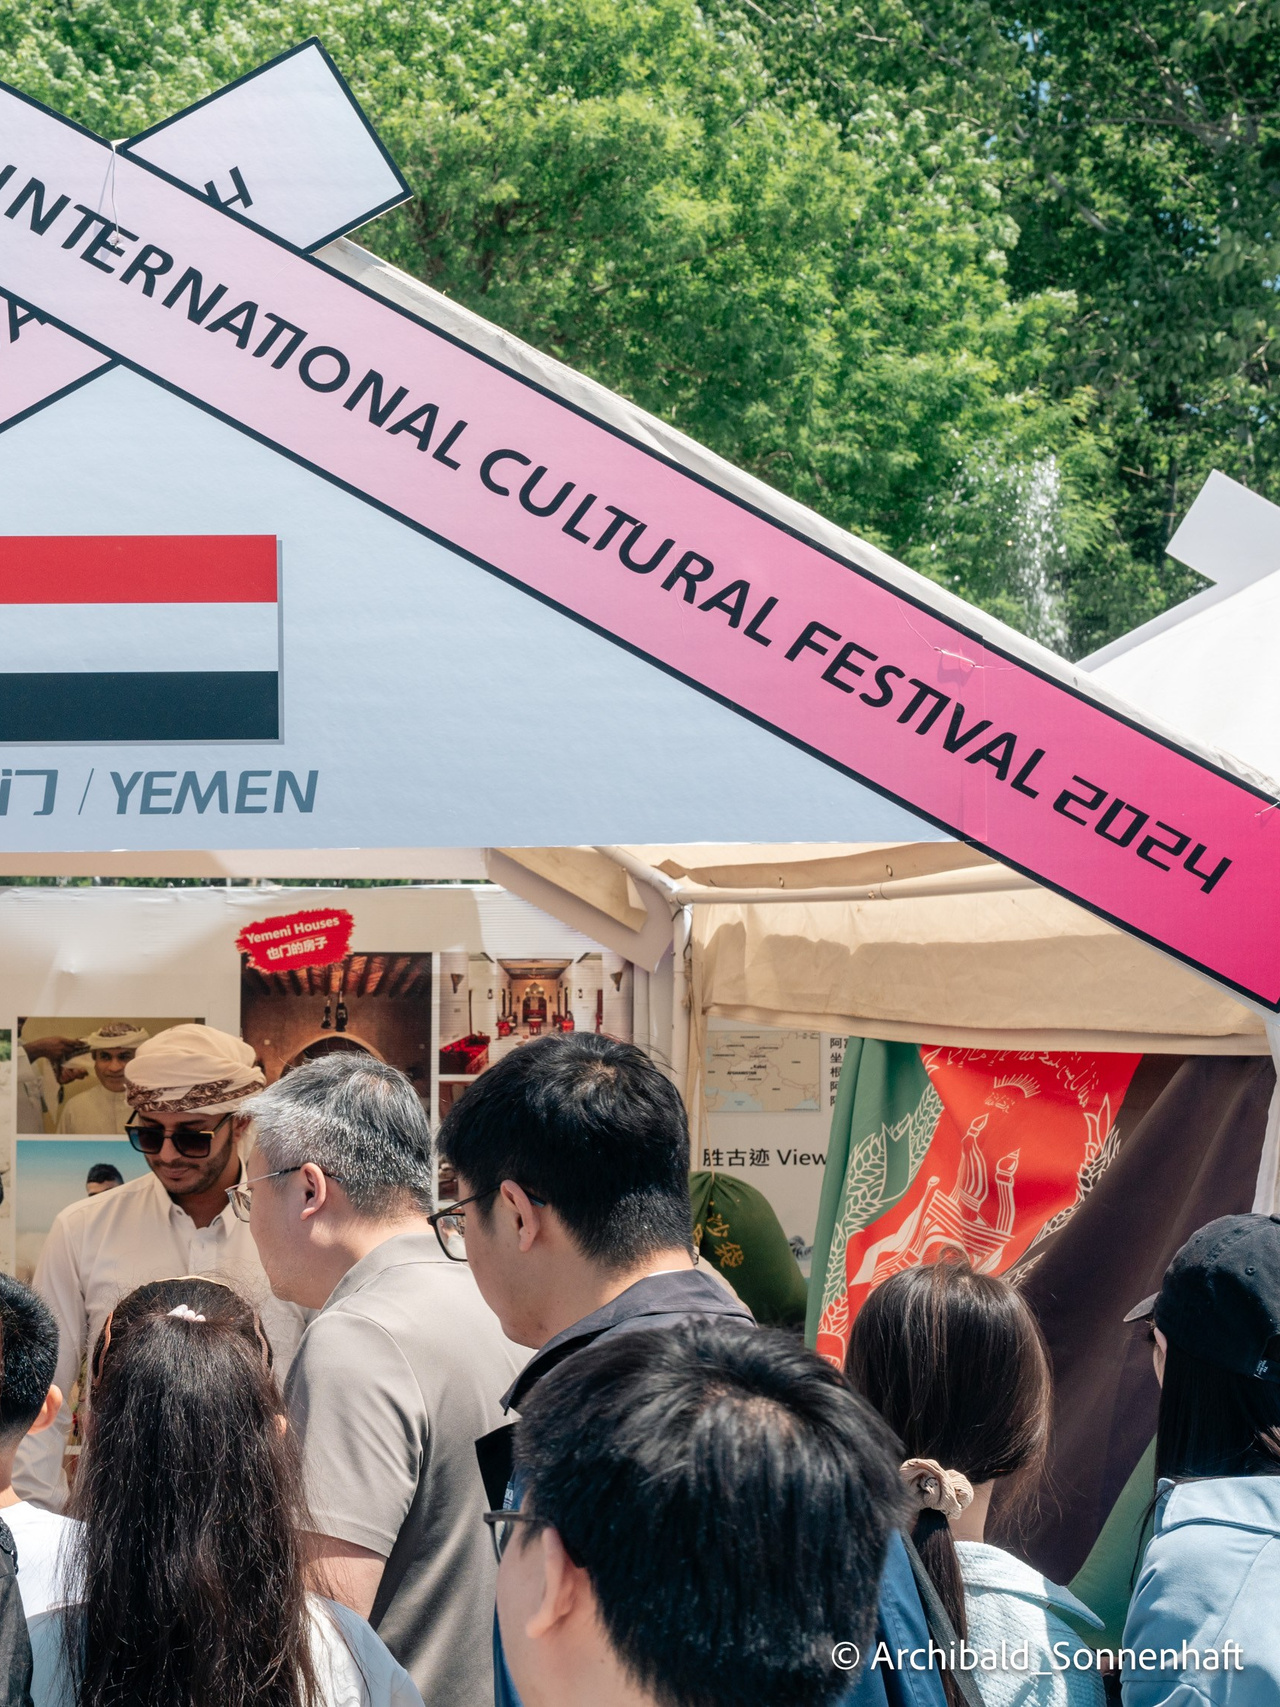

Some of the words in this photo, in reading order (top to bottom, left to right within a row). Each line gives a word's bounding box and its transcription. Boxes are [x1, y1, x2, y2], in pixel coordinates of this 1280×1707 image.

[479, 448, 779, 648] CULTURAL
[784, 621, 1046, 800] FESTIVAL
[1052, 774, 1233, 895] 2024
[109, 769, 319, 815] YEMEN
[246, 925, 292, 944] Yemeni
[293, 917, 340, 934] Houses
[266, 936, 328, 960] 也门的房子
